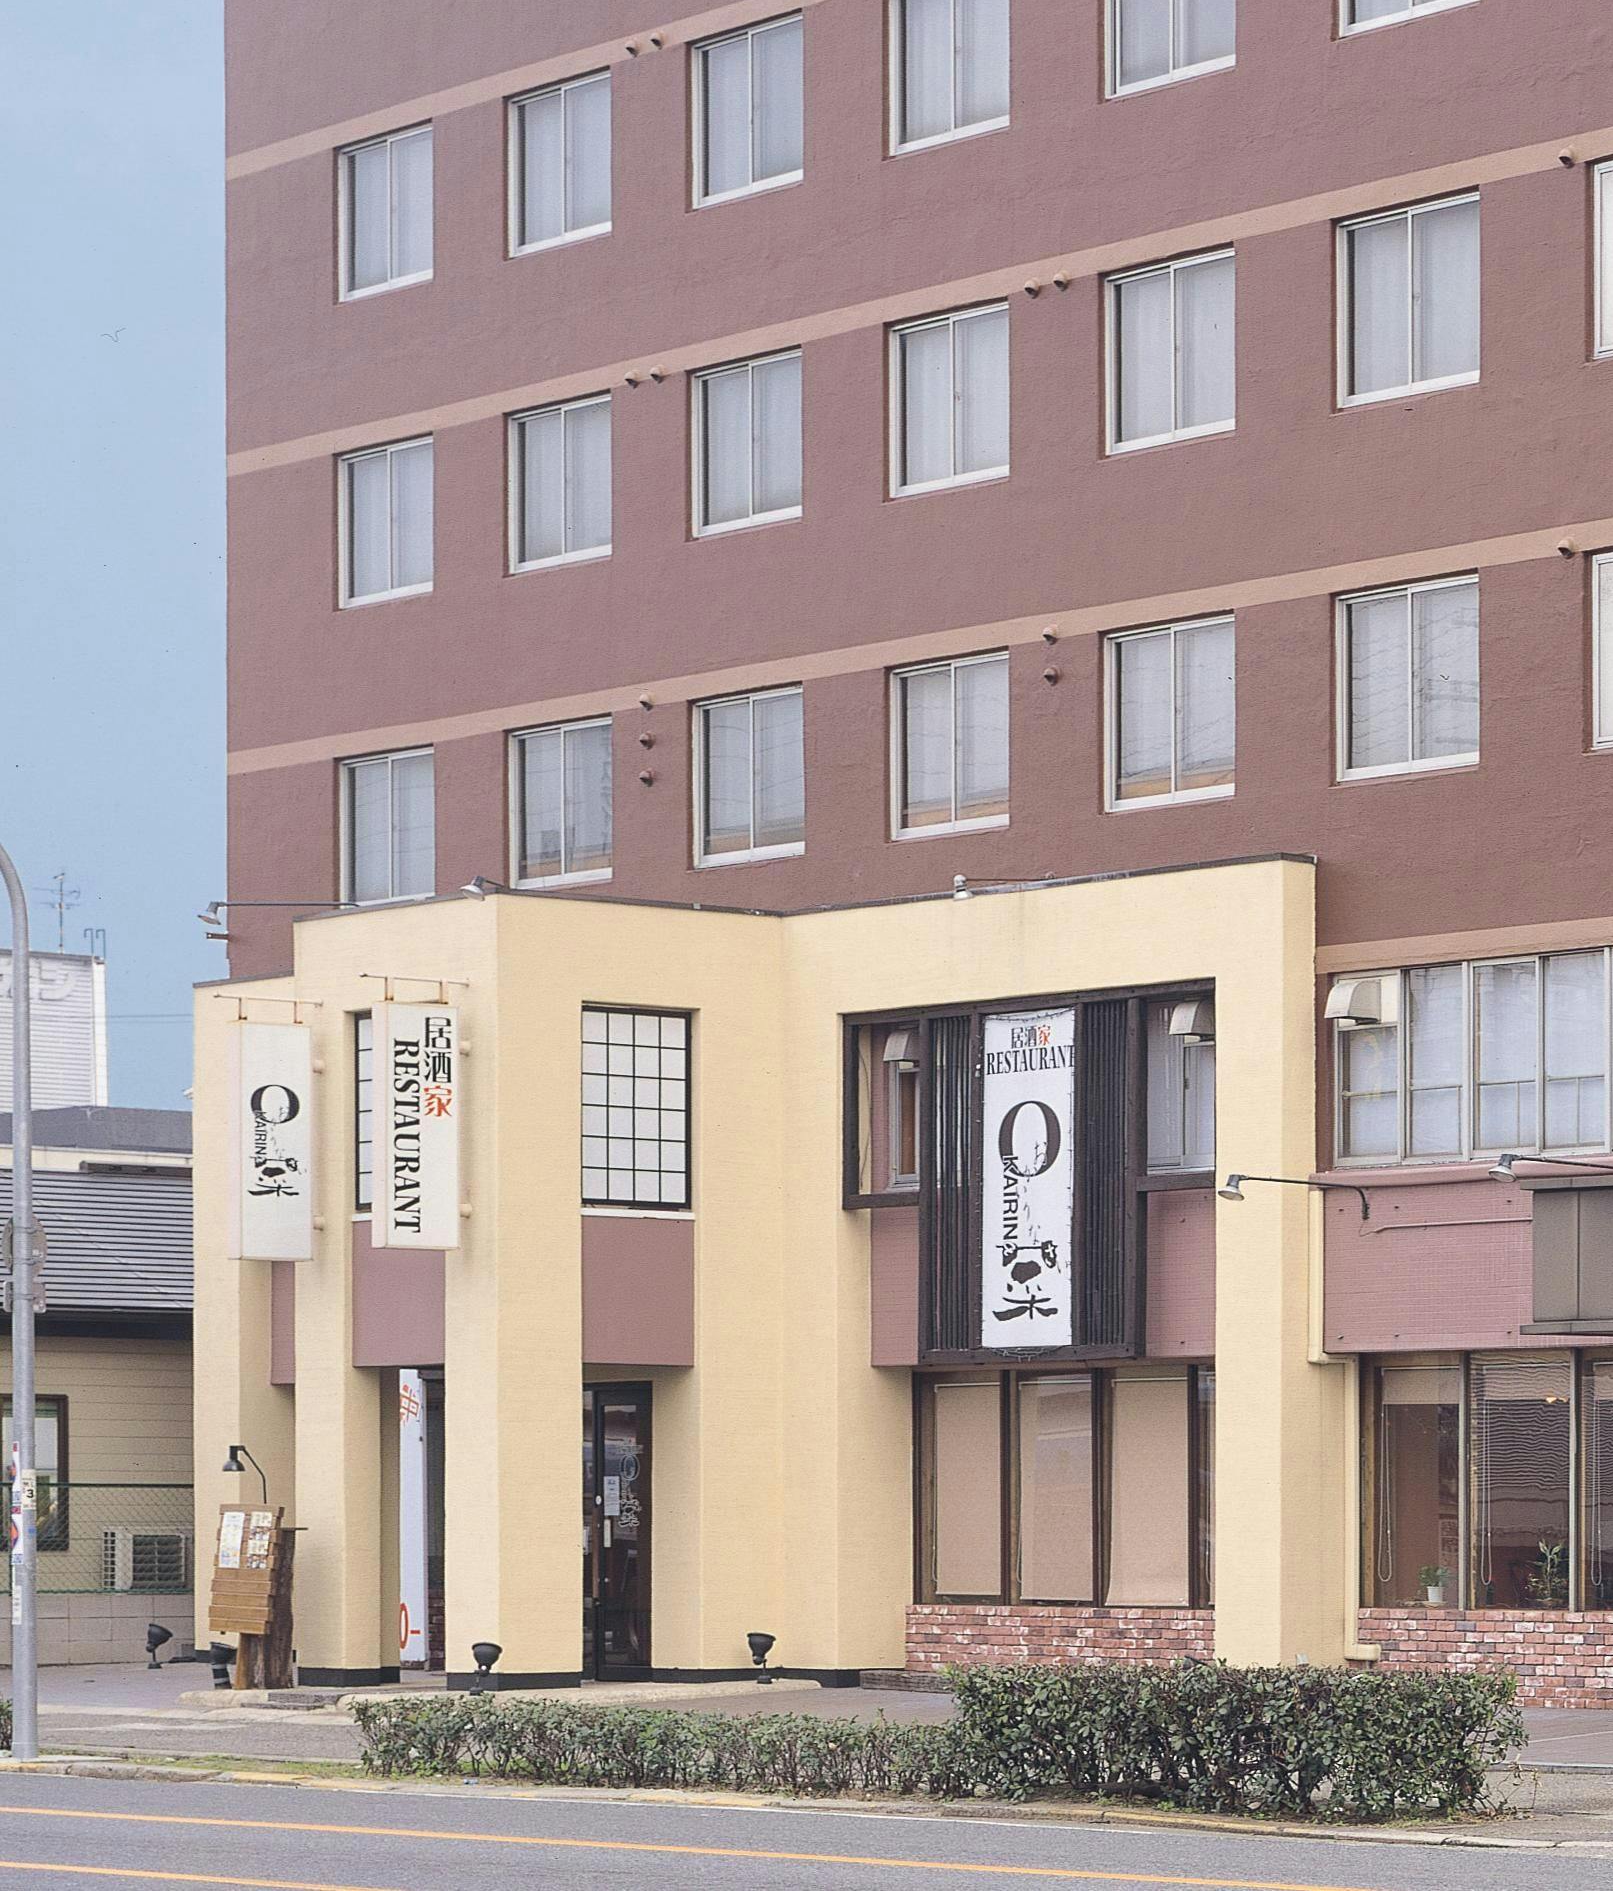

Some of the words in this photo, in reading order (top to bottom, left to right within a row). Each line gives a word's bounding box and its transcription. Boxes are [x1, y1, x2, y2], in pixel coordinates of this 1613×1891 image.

[393, 1038, 421, 1233] RESTAURANT
[425, 1017, 452, 1117] 居酒家
